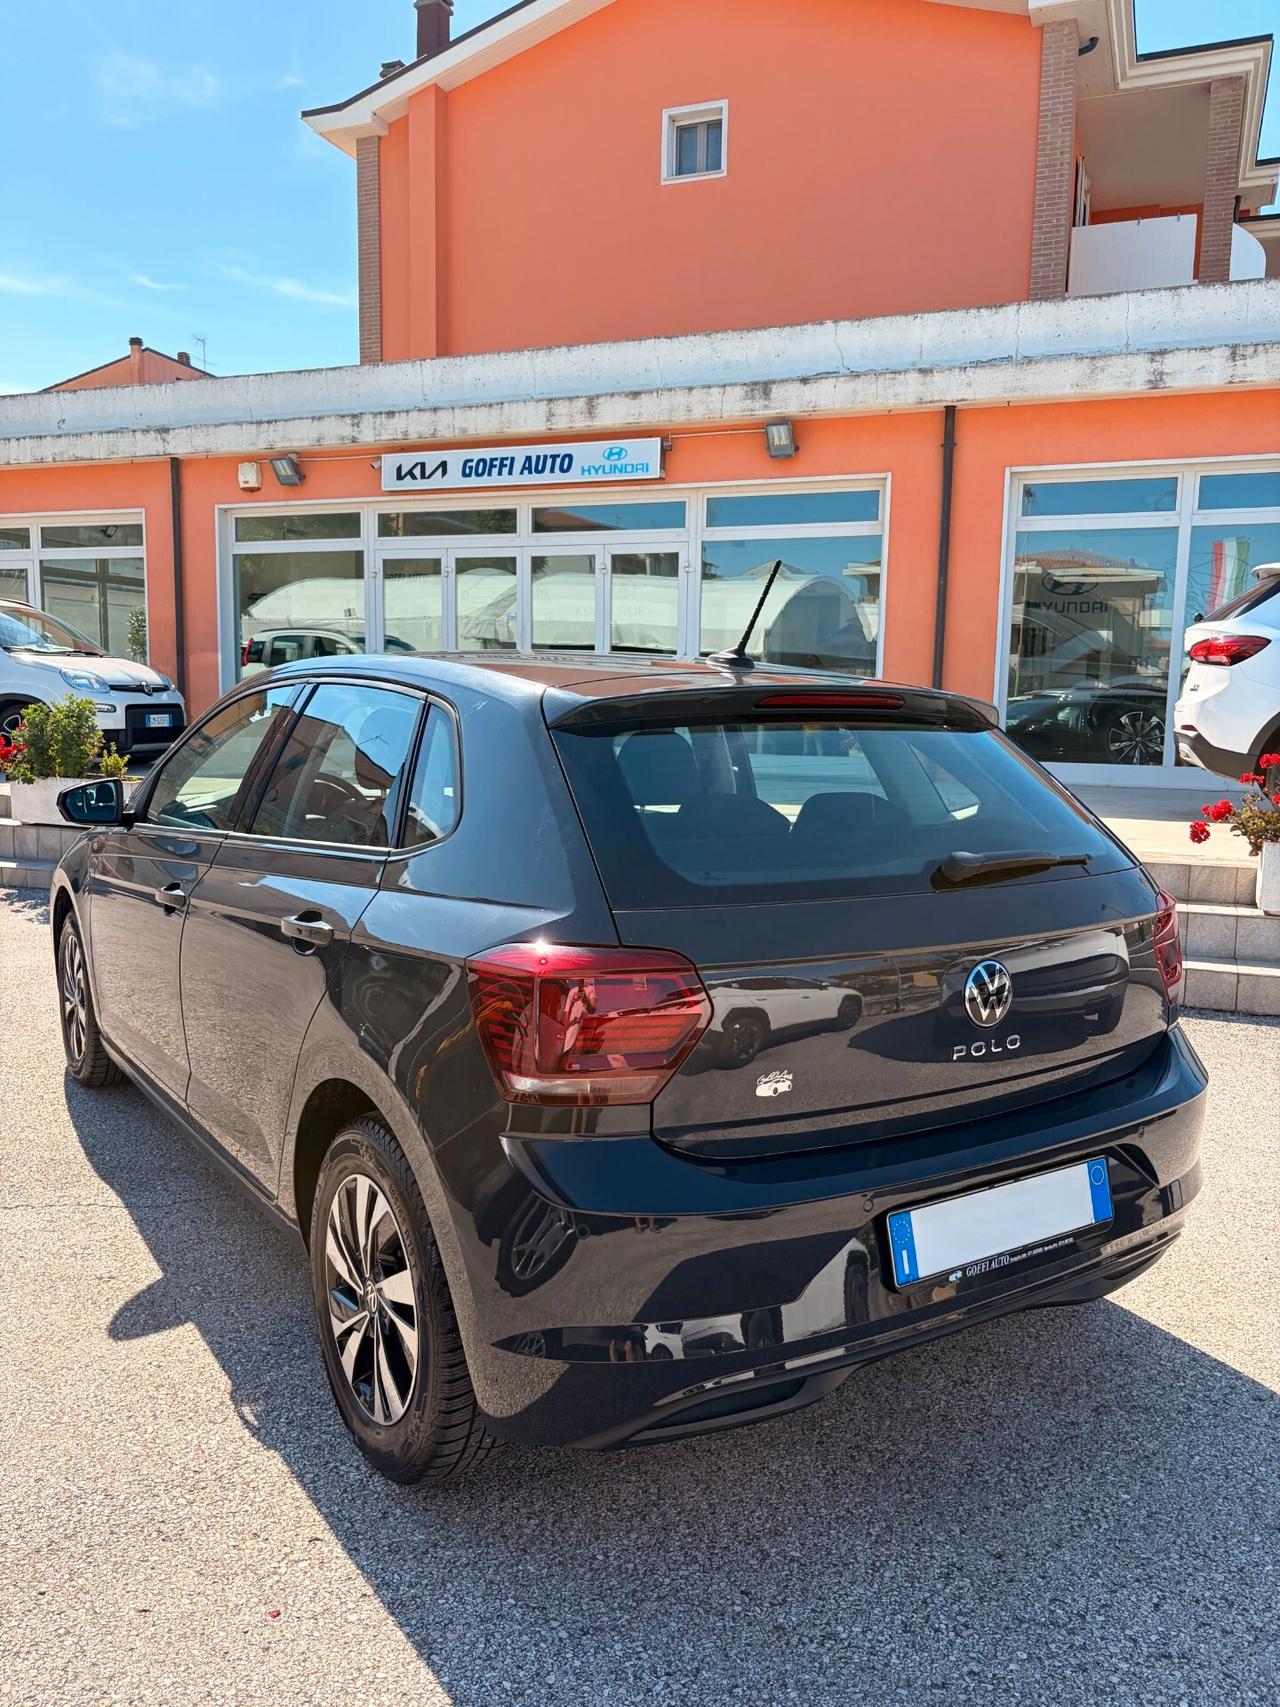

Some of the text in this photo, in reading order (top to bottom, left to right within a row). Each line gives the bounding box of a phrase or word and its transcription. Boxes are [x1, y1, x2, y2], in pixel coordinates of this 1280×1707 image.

[396, 460, 448, 481] KIA
[461, 453, 574, 478] GOFFI AUTO
[580, 462, 649, 476] HYUNDAI
[953, 1035, 1020, 1060] POLO
[966, 1255, 1010, 1277] GOFFI AUTO
